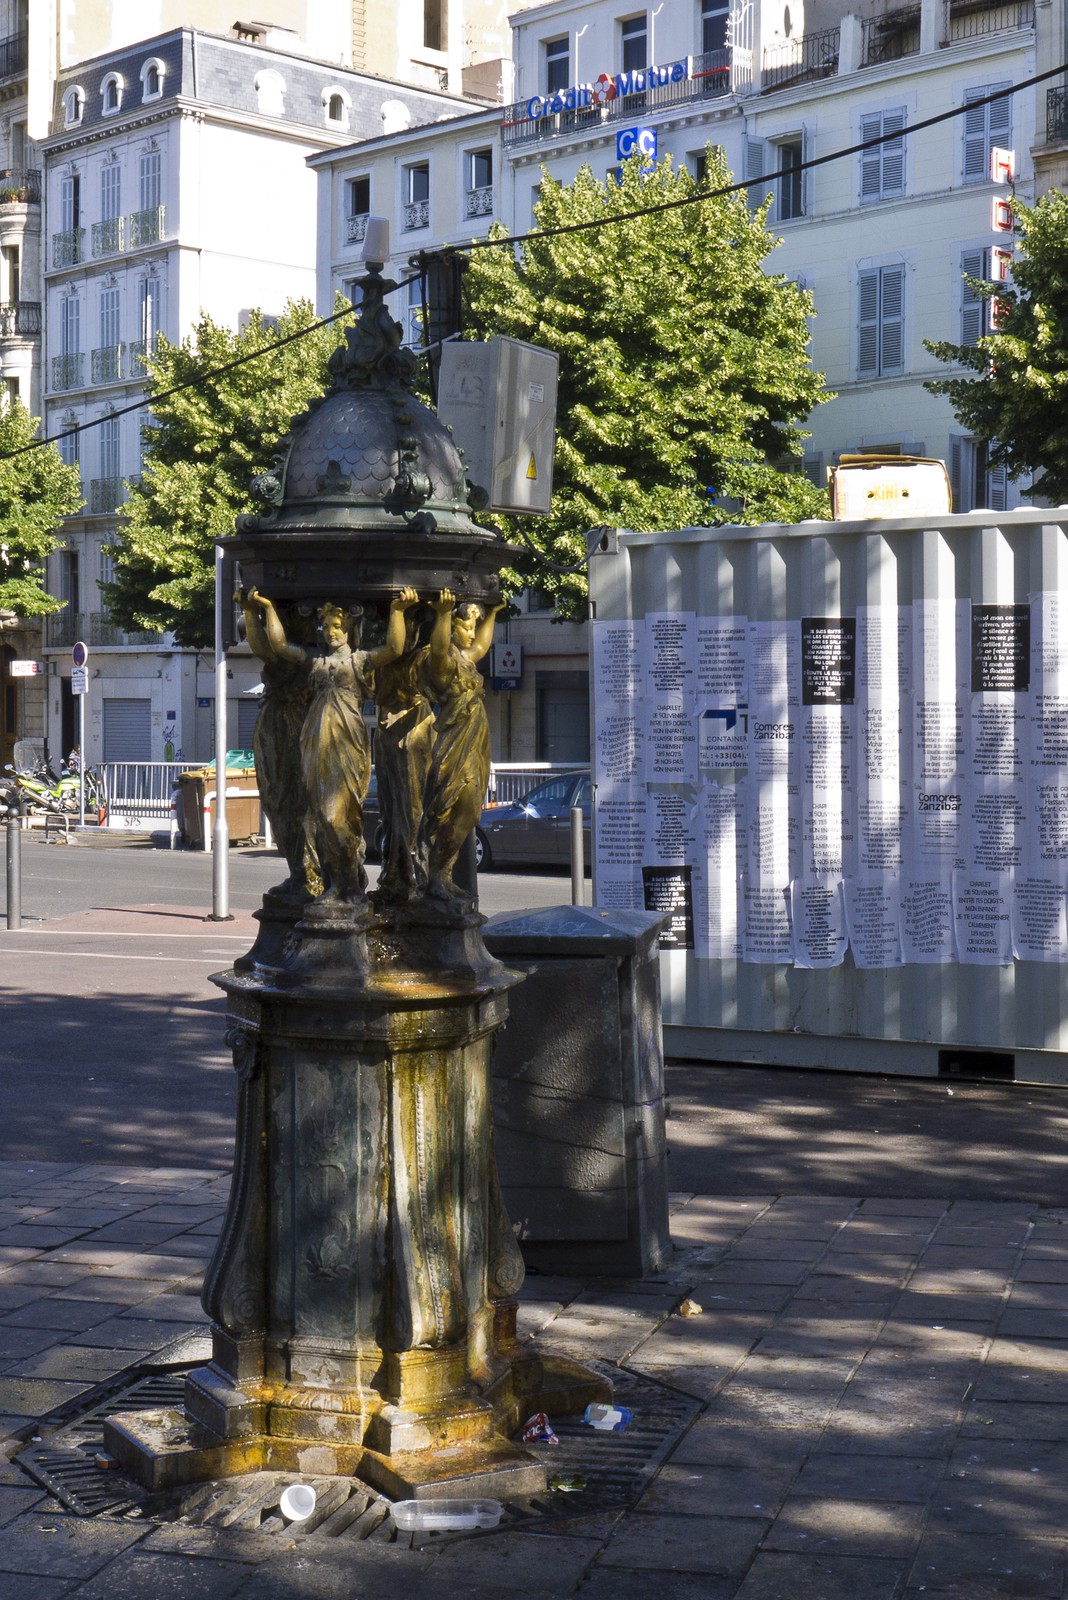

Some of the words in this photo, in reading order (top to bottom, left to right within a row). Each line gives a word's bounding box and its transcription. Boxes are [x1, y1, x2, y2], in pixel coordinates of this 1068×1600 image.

[528, 84, 593, 120] Crédit
[616, 56, 692, 98] Mutuel
[754, 722, 794, 731] Comores
[754, 731, 795, 740] Zanzibar
[919, 793, 961, 803] Comores
[918, 802, 962, 810] Zanzibar
[124, 817, 142, 826] SPS
